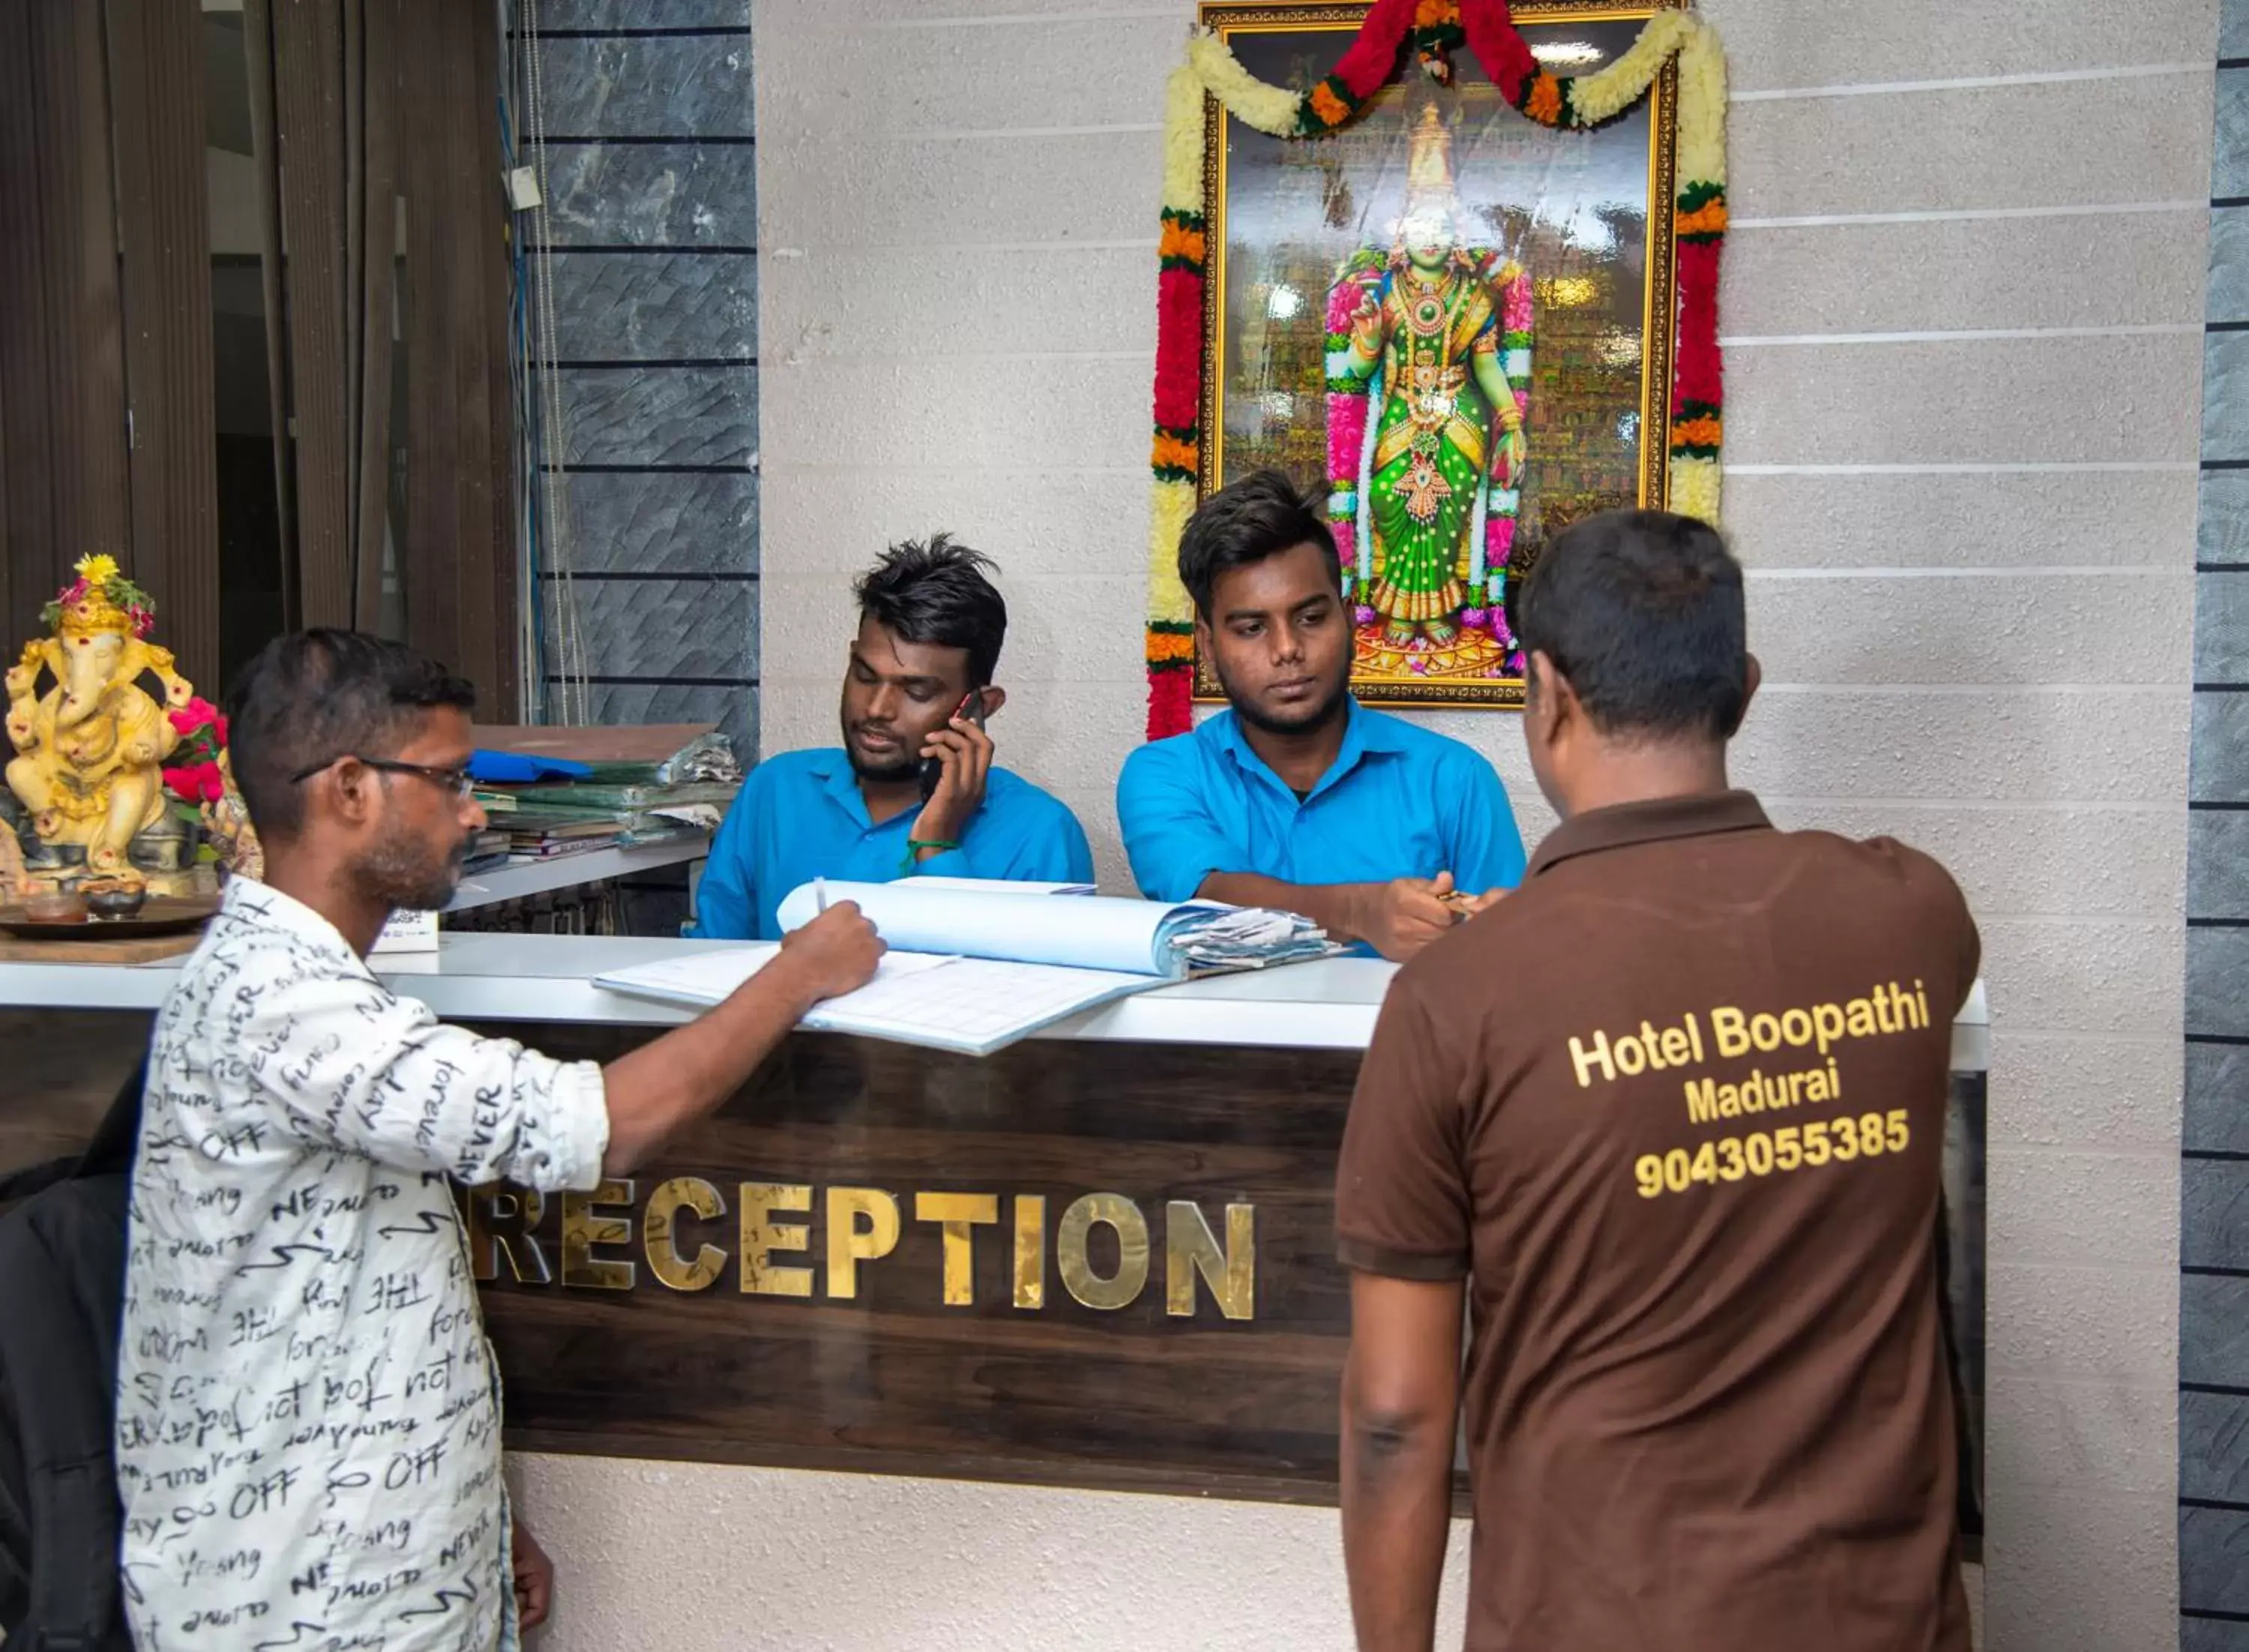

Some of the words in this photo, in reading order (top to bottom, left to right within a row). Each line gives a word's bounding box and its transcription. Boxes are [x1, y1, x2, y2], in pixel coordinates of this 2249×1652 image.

[1568, 1013, 1704, 1088] Hotel
[1710, 979, 1930, 1055] Boopathi
[453, 1082, 502, 1182] NEVER
[1684, 1057, 1841, 1124] Madurai
[1634, 1109, 1910, 1199] 9043055385
[468, 1175, 1256, 1321] RECEPTION
[229, 1466, 303, 1520] OFF
[384, 1436, 450, 1490] OFF
